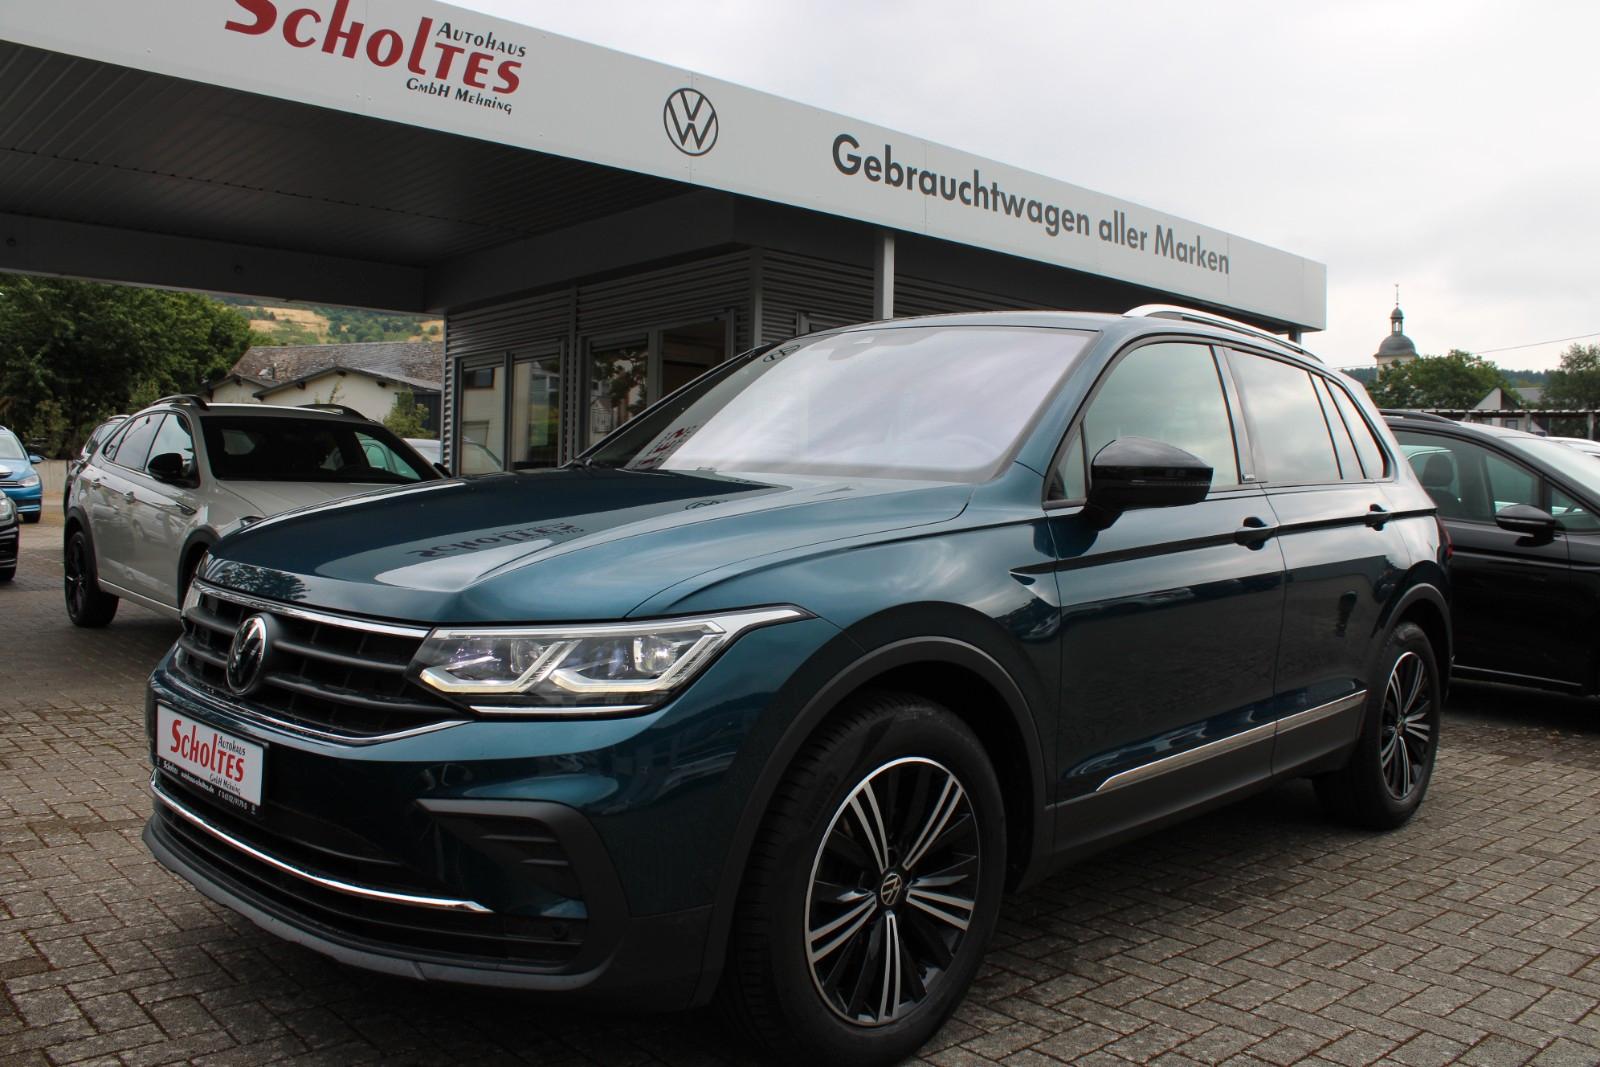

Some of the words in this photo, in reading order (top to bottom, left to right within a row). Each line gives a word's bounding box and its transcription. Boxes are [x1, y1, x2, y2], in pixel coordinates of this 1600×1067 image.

[831, 133, 1090, 237] Gebrauchtwagen
[1098, 210, 1148, 251] aller
[1153, 224, 1230, 275] Marken
